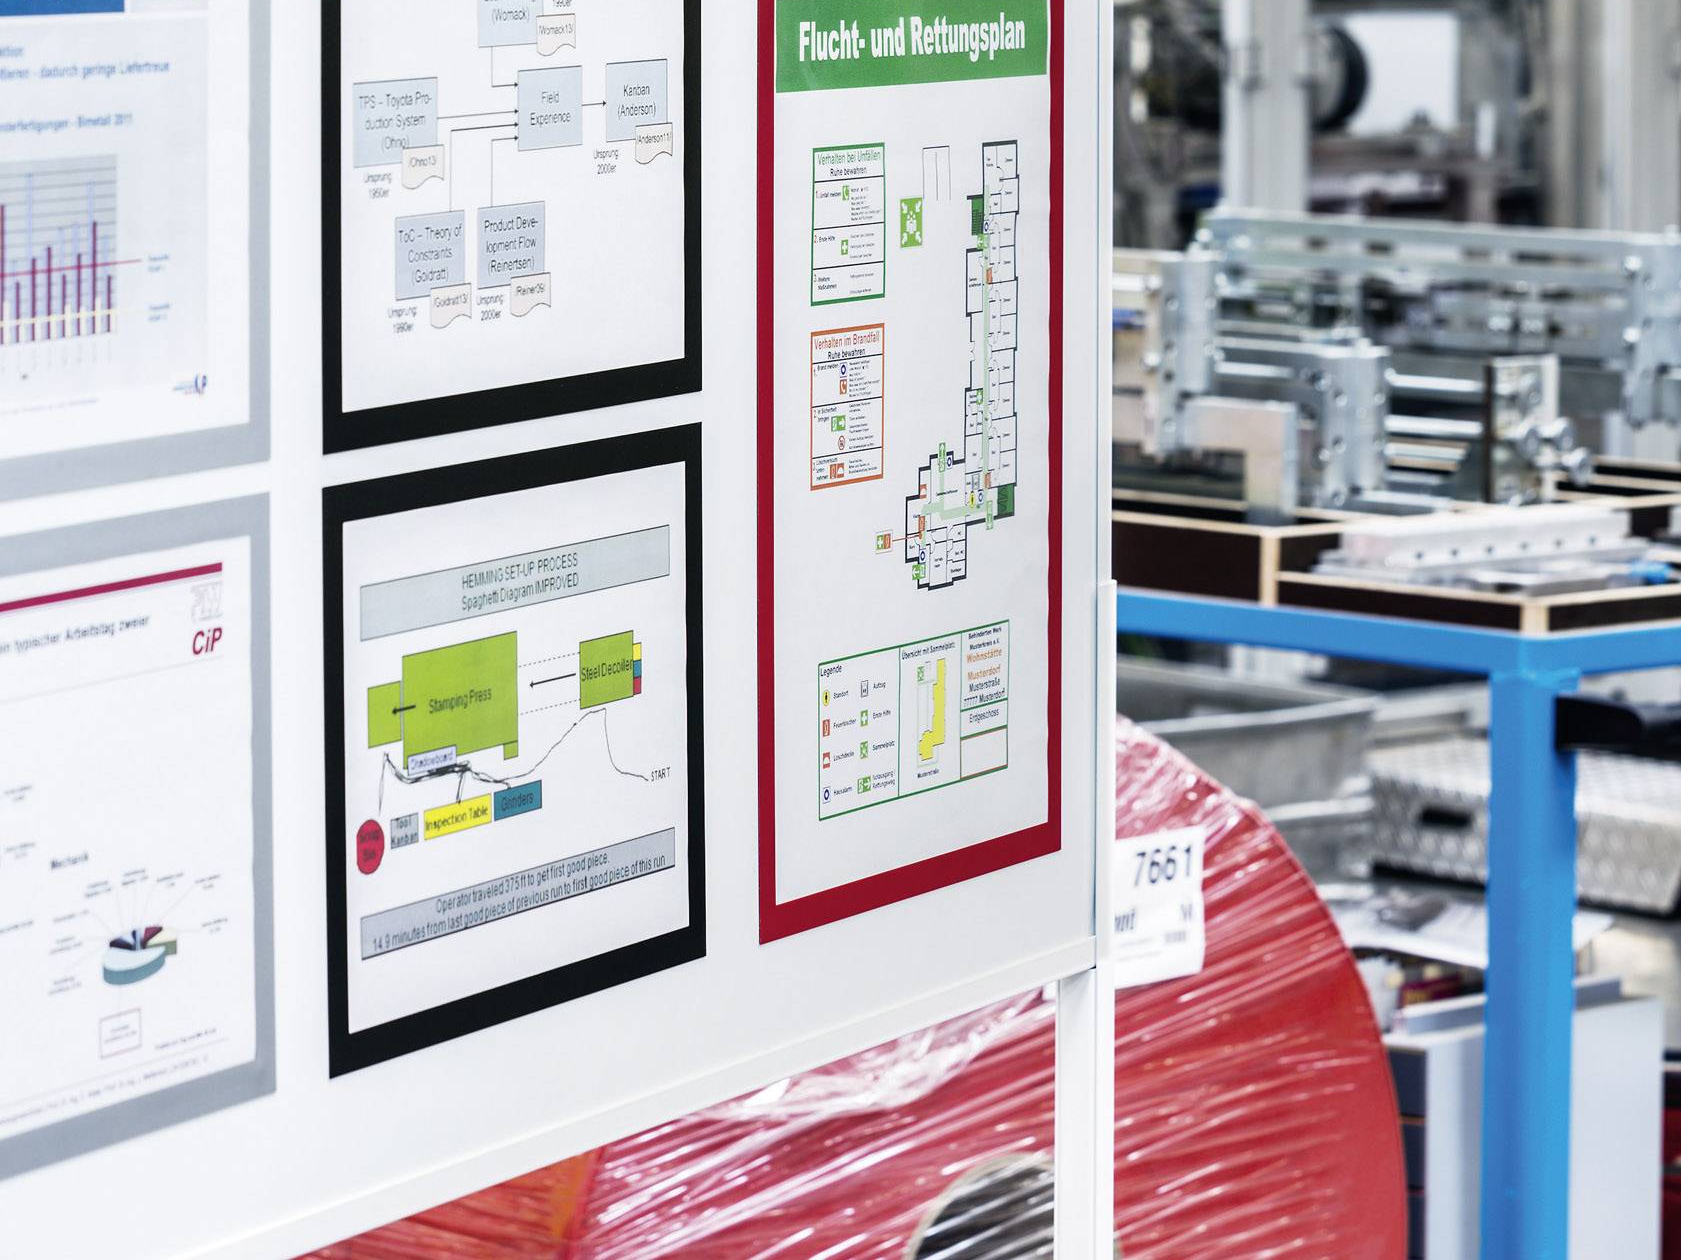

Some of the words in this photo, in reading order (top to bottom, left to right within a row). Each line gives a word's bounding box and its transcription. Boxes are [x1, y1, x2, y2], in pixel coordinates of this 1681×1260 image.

[491, 5, 530, 24] (Womack)
[799, 19, 866, 62] Flucht-
[871, 16, 906, 59] und
[910, 11, 1026, 63] Rettungsplan
[358, 94, 376, 110] TPS
[386, 91, 413, 109] Toyota
[541, 91, 560, 106] Field
[623, 83, 651, 99] Kanban
[617, 102, 657, 119] (Anderson)
[395, 114, 426, 133] System
[530, 111, 572, 130] Experience
[593, 147, 619, 162] Ursprung
[817, 153, 846, 166] Verhalten
[830, 167, 844, 177] Ruhe
[844, 166, 868, 176] bewahren
[398, 227, 416, 243] ToC
[425, 223, 452, 242] Theory
[453, 223, 463, 238] of
[484, 217, 515, 234] Product
[516, 215, 539, 232] Deve-
[518, 235, 537, 250] Flow
[408, 246, 453, 265] Constraints
[411, 266, 450, 285] (Goldratt)
[487, 257, 535, 276] (Reinertsen)
[814, 336, 843, 350] Verhalten
[844, 336, 852, 347] im
[852, 331, 881, 345] Brandfall
[827, 351, 841, 360] Ruhe
[841, 347, 866, 359] bewahren
[461, 566, 505, 590] HEMMING
[504, 560, 535, 581] SET-UP
[537, 551, 579, 575] PROCESS
[461, 586, 500, 612] Spaghetti
[500, 582, 534, 605] Diagram
[534, 572, 580, 597] IMPROVED
[65, 622, 115, 640] Arbeitstag
[192, 627, 223, 656] CiP
[580, 660, 601, 683] Steel
[820, 664, 843, 678] Legende
[967, 664, 1001, 681] Musterdorf
[969, 677, 1001, 692] Musterstraße
[428, 691, 469, 714] Stamping
[469, 687, 492, 706] Press
[650, 766, 671, 782] START
[425, 808, 467, 832] Inspection
[468, 805, 489, 821] Table
[1134, 844, 1192, 887] 7661
[435, 892, 472, 914] Operator
[472, 882, 505, 905] traveled
[505, 878, 520, 895] 375
[527, 875, 535, 888] to
[536, 870, 550, 889] get
[550, 863, 565, 882] first
[567, 862, 586, 883] good
[587, 853, 610, 875] piece.
[391, 926, 427, 947] minutes
[426, 919, 447, 937] from
[447, 913, 463, 930] last
[464, 909, 484, 929] good
[484, 902, 507, 924] piece
[507, 897, 516, 914] of
[516, 889, 550, 910] previous
[550, 885, 564, 900] run
[563, 882, 571, 896] to
[572, 876, 588, 894] first
[589, 870, 609, 890] good
[609, 865, 629, 885] piece
[630, 862, 638, 876] of
[638, 857, 652, 875] this
[653, 854, 666, 871] run
